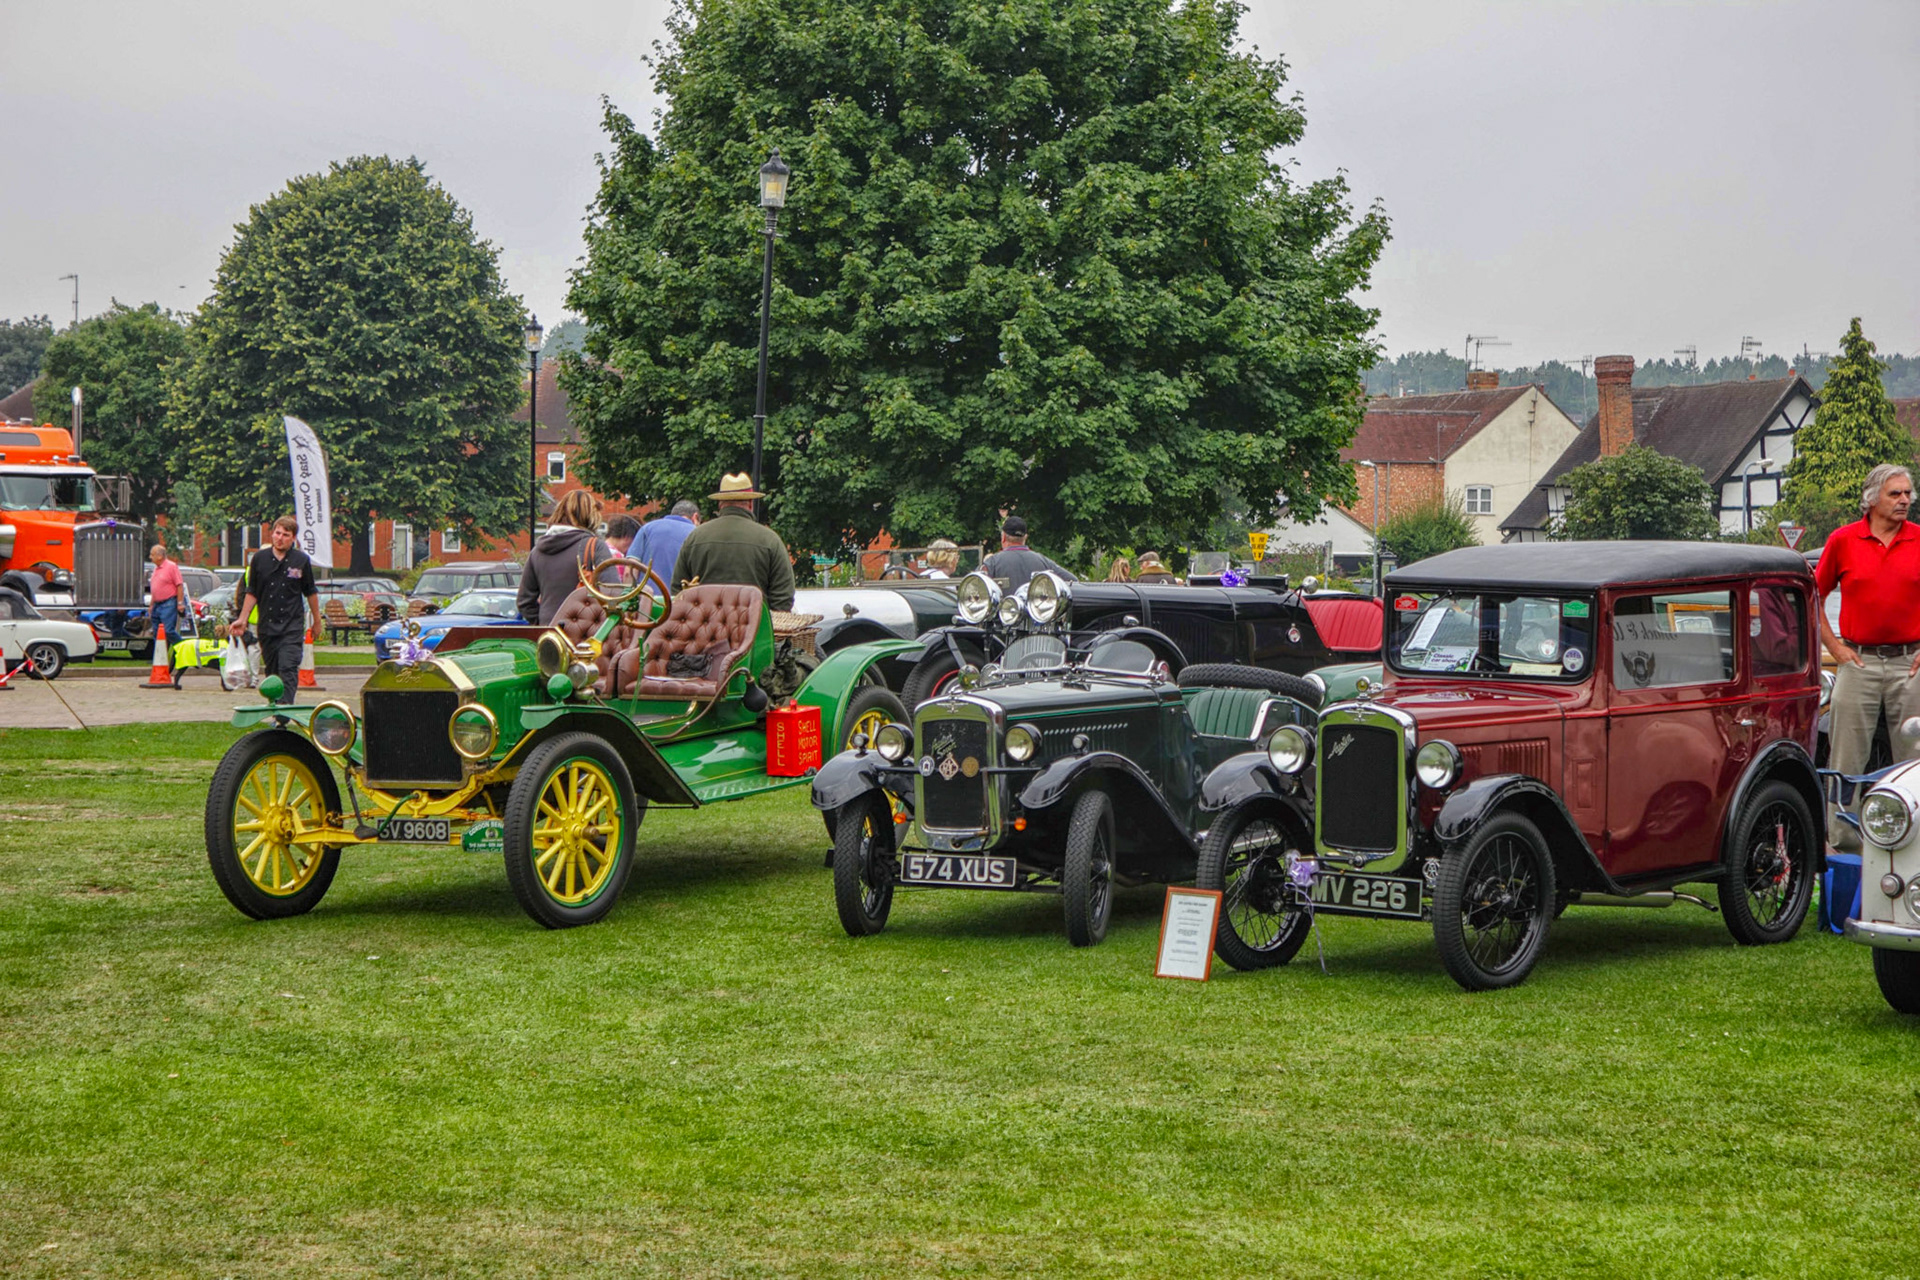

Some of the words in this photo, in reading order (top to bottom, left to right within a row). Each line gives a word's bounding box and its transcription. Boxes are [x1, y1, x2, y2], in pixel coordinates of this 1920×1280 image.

[798, 720, 817, 736] SHELL
[776, 721, 786, 767] SHELL
[798, 735, 818, 750] MOTOR
[798, 750, 818, 766] SPIRIT
[403, 821, 447, 840] 9608
[468, 820, 490, 836] GORDON
[909, 857, 953, 881] 574
[958, 858, 1006, 883] XUS
[1311, 875, 1346, 904] MV
[1352, 878, 1407, 910] 226
